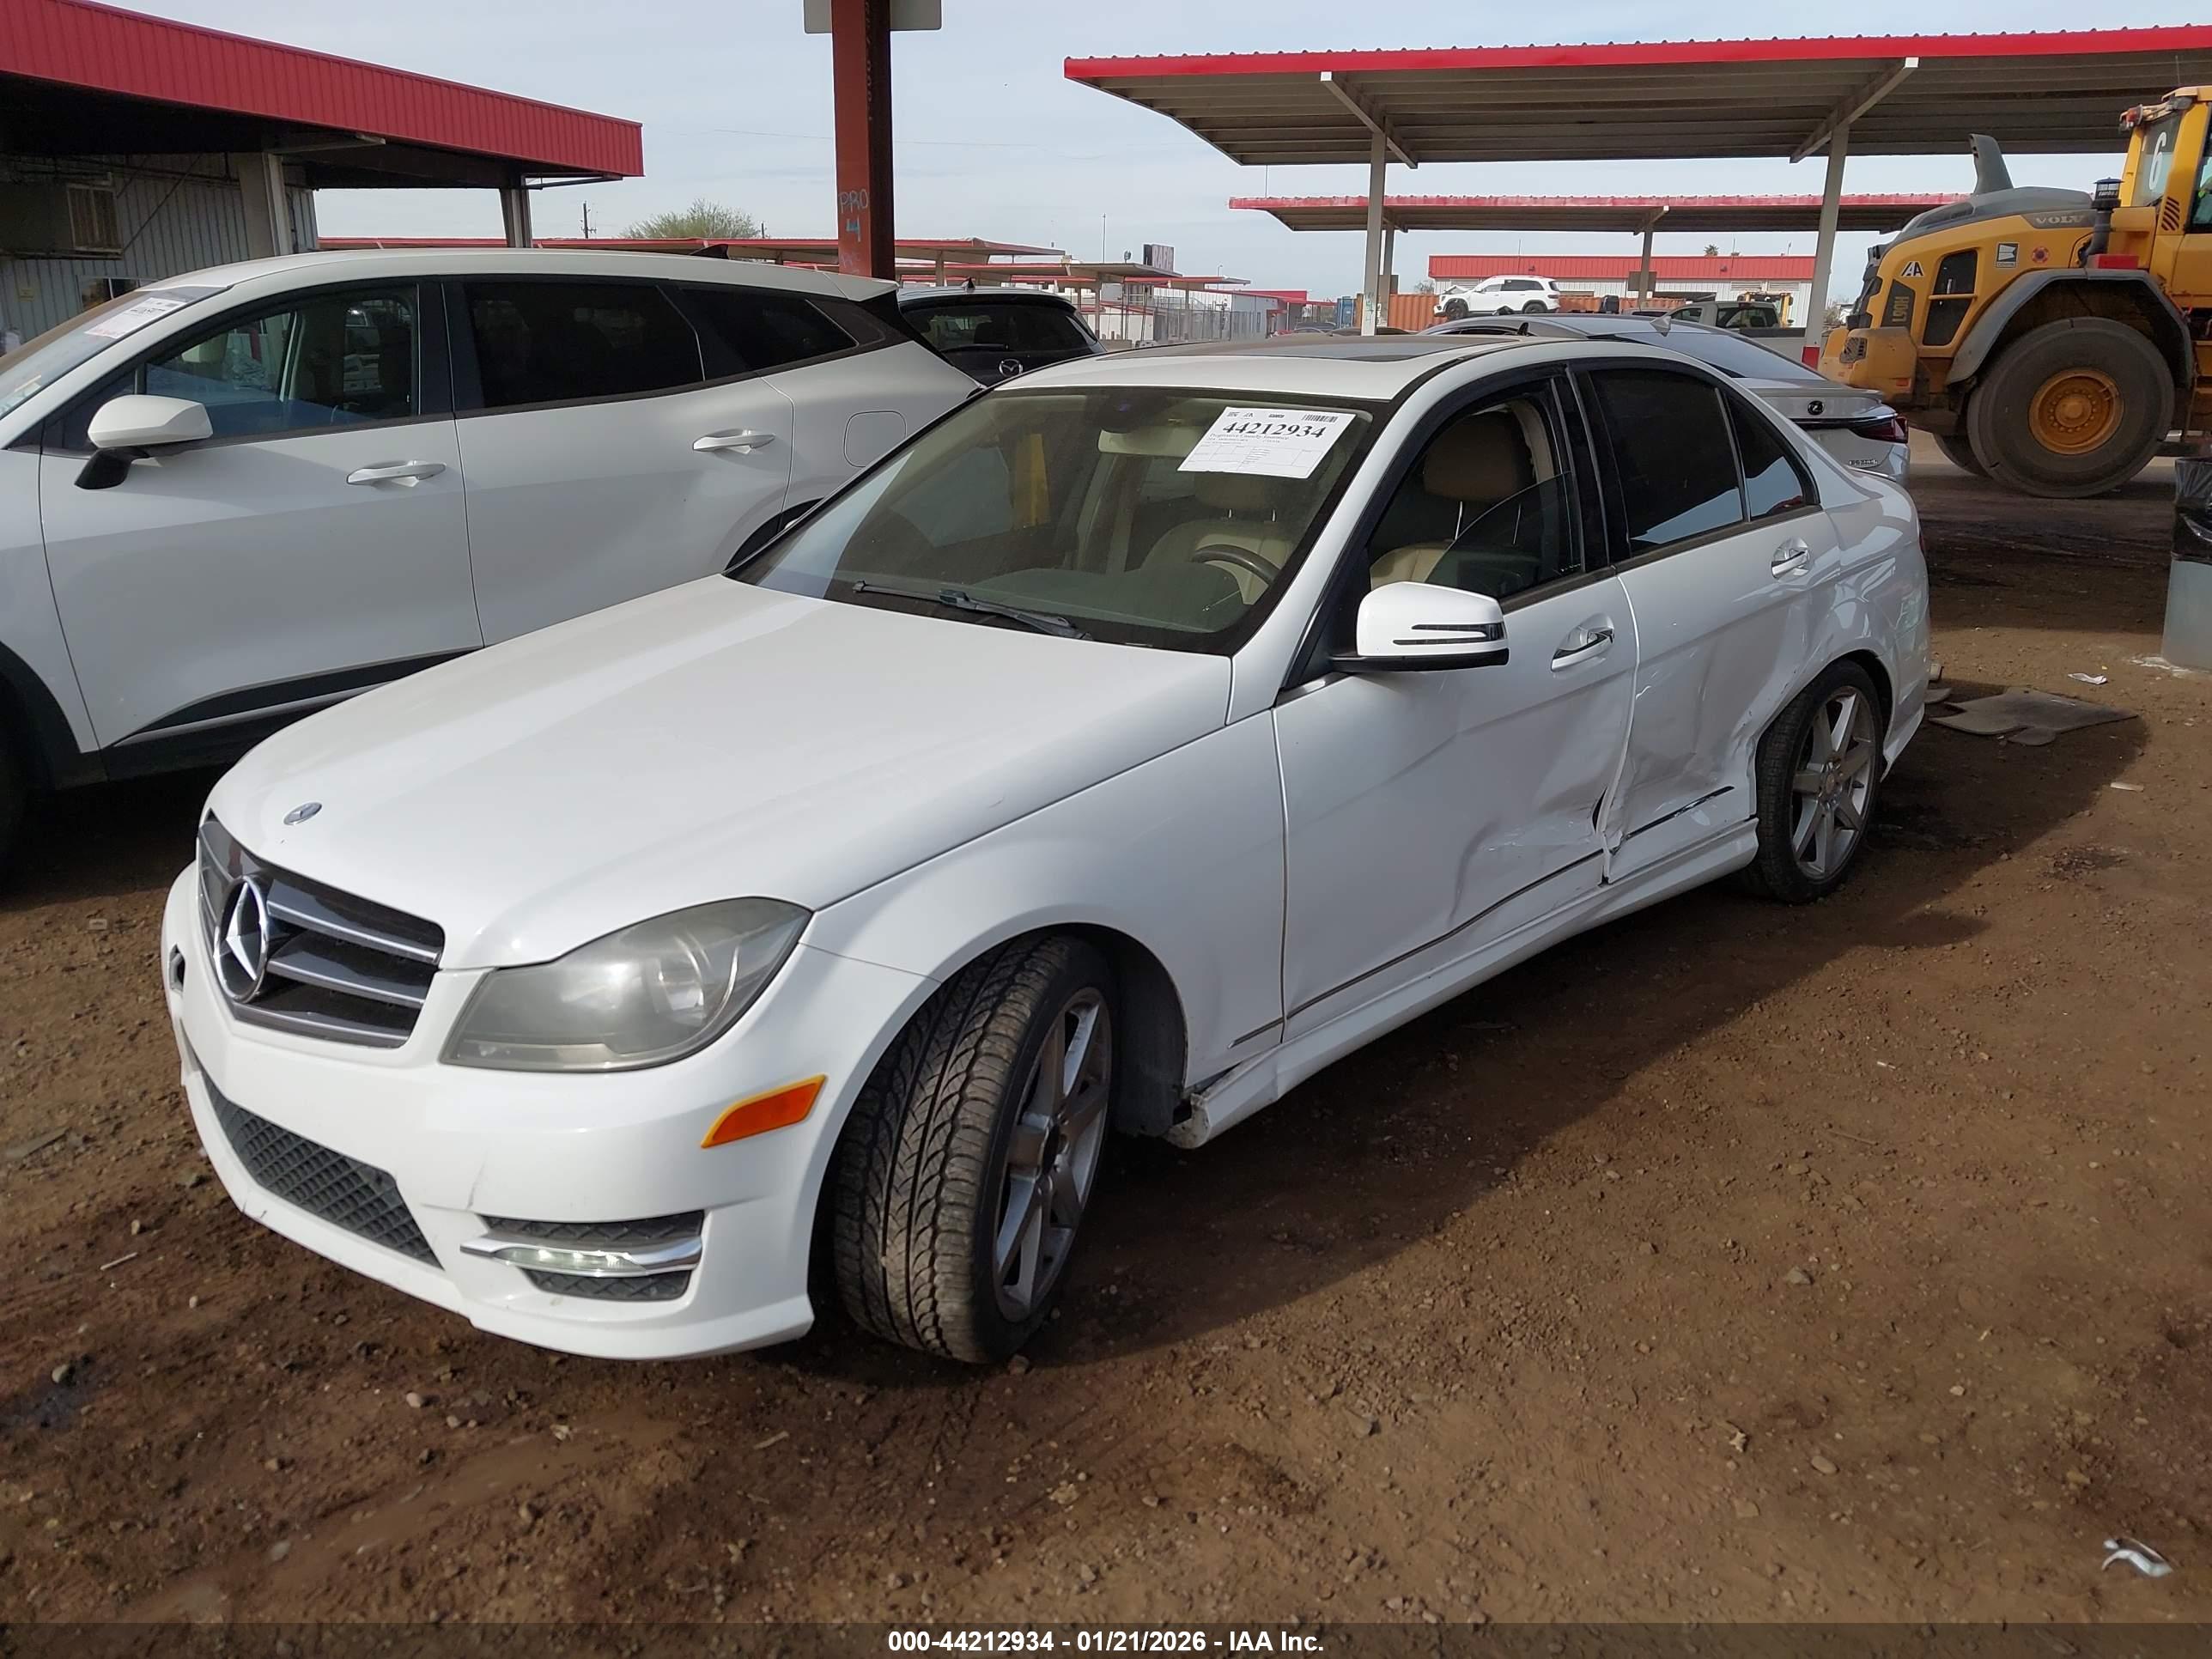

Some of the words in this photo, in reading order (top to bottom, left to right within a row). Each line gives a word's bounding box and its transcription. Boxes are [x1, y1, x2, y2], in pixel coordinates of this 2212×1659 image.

[2148, 131, 2166, 190] 6
[839, 189, 869, 214] PRO
[845, 216, 861, 243] 4
[2035, 215, 2084, 224] VOLV
[1892, 295, 1910, 323] L90H
[1223, 422, 1327, 438] 44212934
